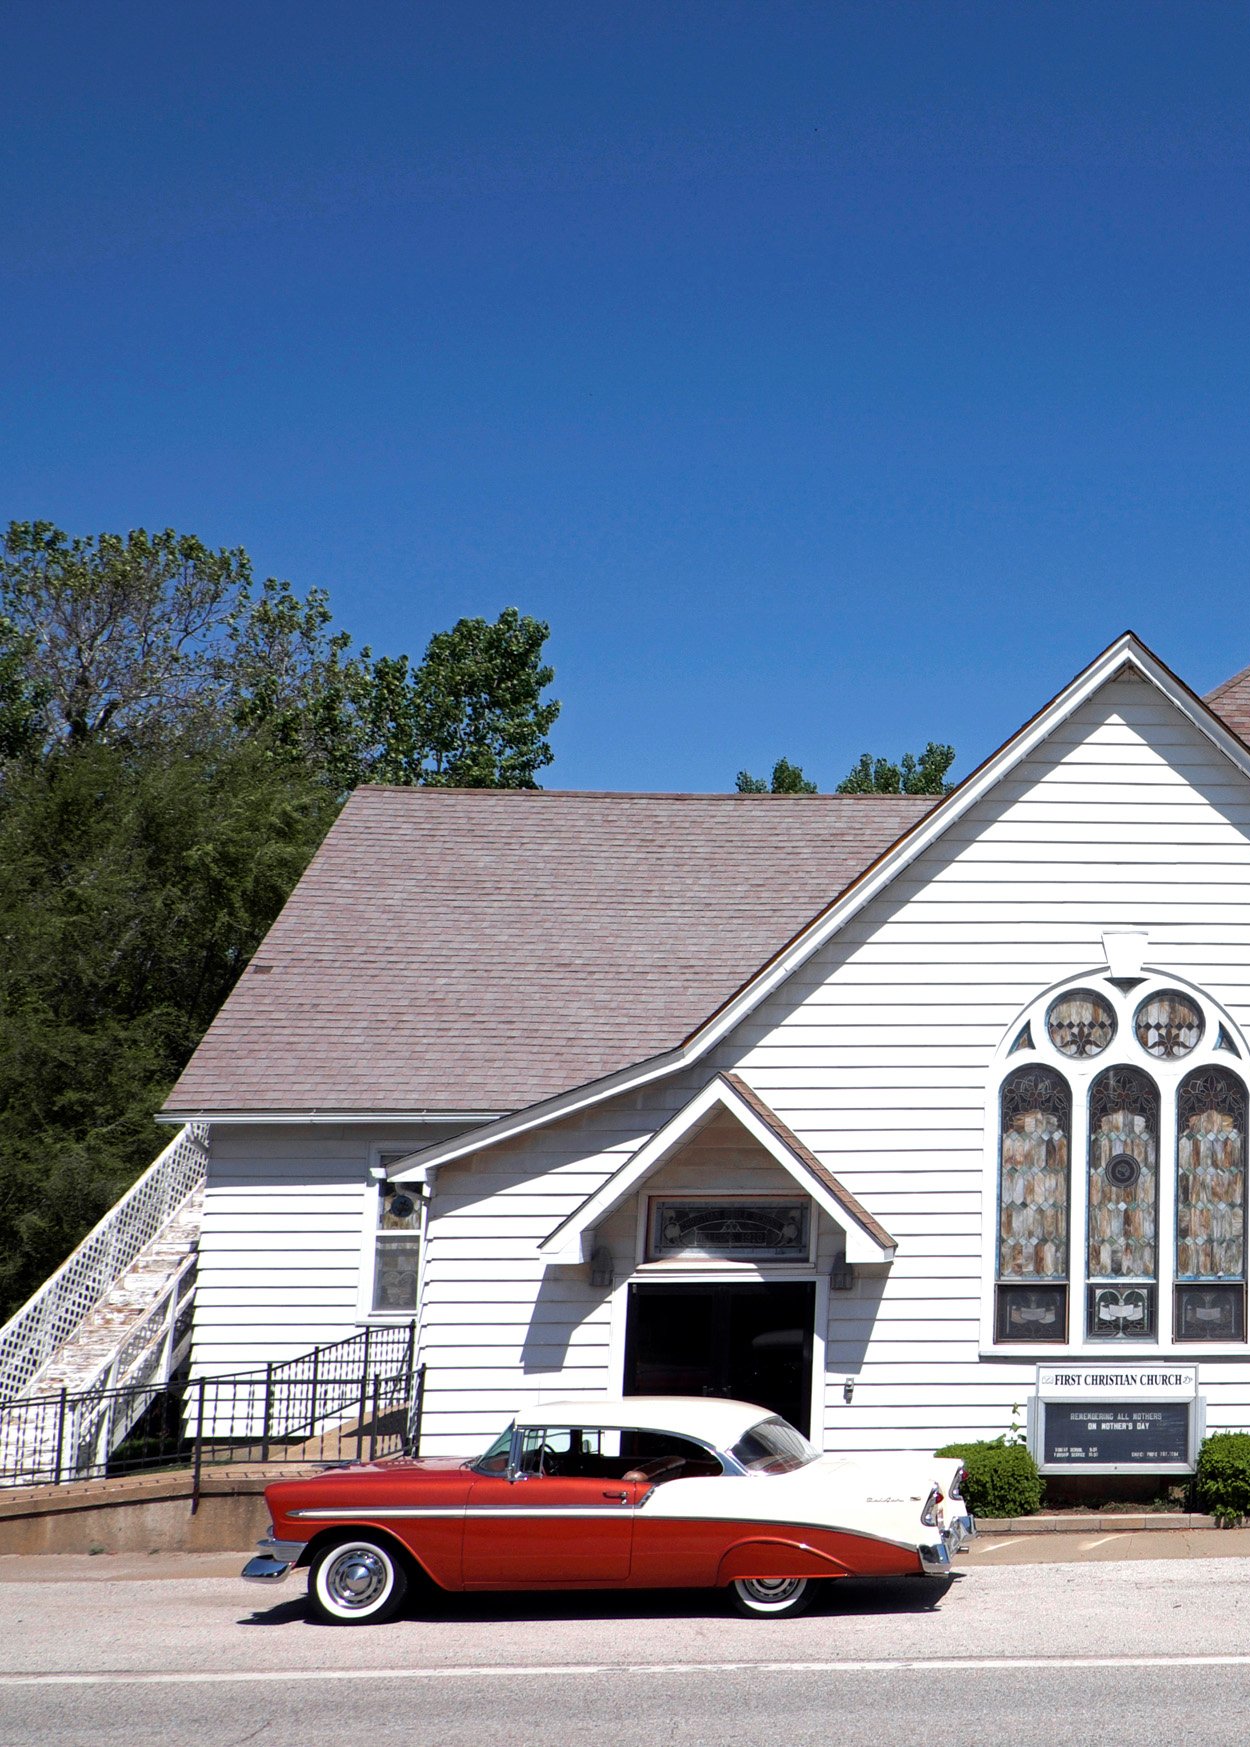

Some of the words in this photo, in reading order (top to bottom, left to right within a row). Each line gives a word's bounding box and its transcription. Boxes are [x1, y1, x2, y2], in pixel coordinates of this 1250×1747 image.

[1055, 1374, 1082, 1386] FIRST
[1084, 1374, 1137, 1386] CHRISTIAN
[1139, 1374, 1182, 1386] CHURCH
[1117, 1412, 1129, 1420] ALL
[1133, 1412, 1162, 1420] MOTHERS
[1087, 1422, 1097, 1430] ON
[1101, 1422, 1133, 1430] MOTHER'S
[1137, 1422, 1150, 1430] DAY
